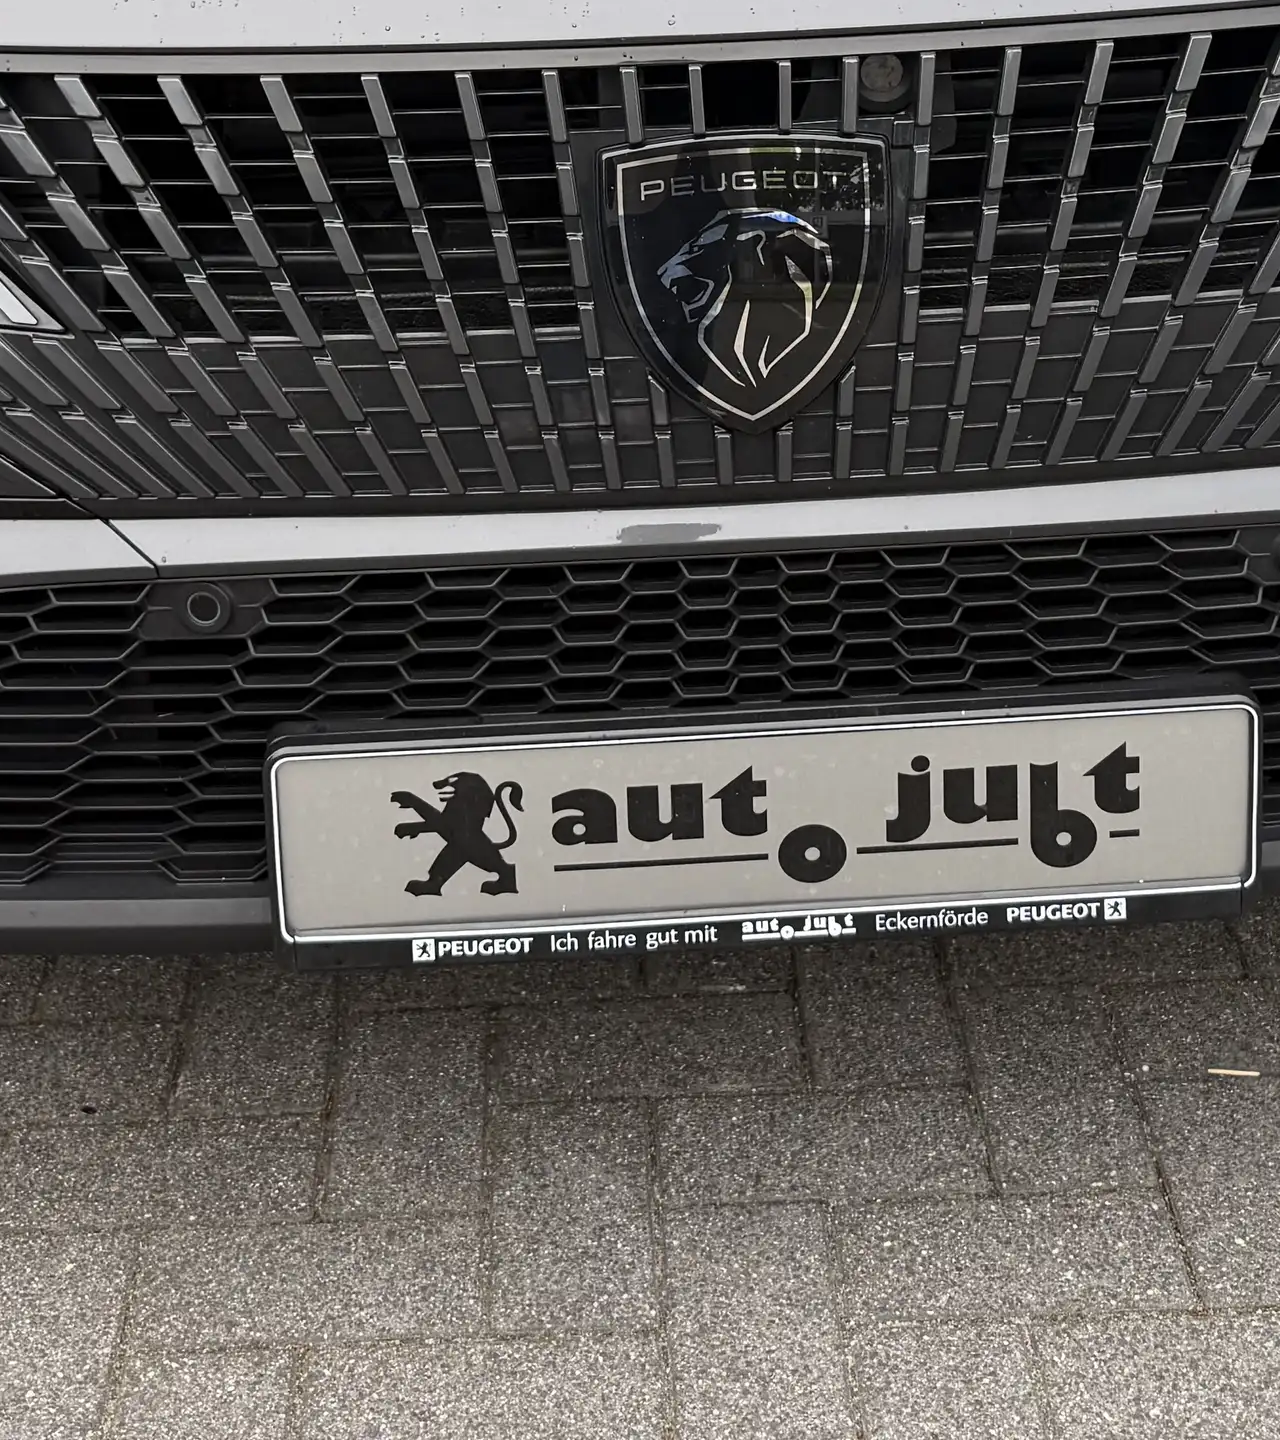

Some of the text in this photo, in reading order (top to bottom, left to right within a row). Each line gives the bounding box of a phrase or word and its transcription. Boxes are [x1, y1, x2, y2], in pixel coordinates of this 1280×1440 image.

[640, 170, 847, 202] PEUGEOT
[437, 936, 534, 958] PEUGEOT
[550, 933, 579, 953] Ich
[587, 928, 637, 950] fahre
[645, 928, 679, 950] gut
[684, 924, 719, 944] mit
[874, 907, 990, 932] Eckernförde
[1005, 902, 1101, 923] PEUGEOT
